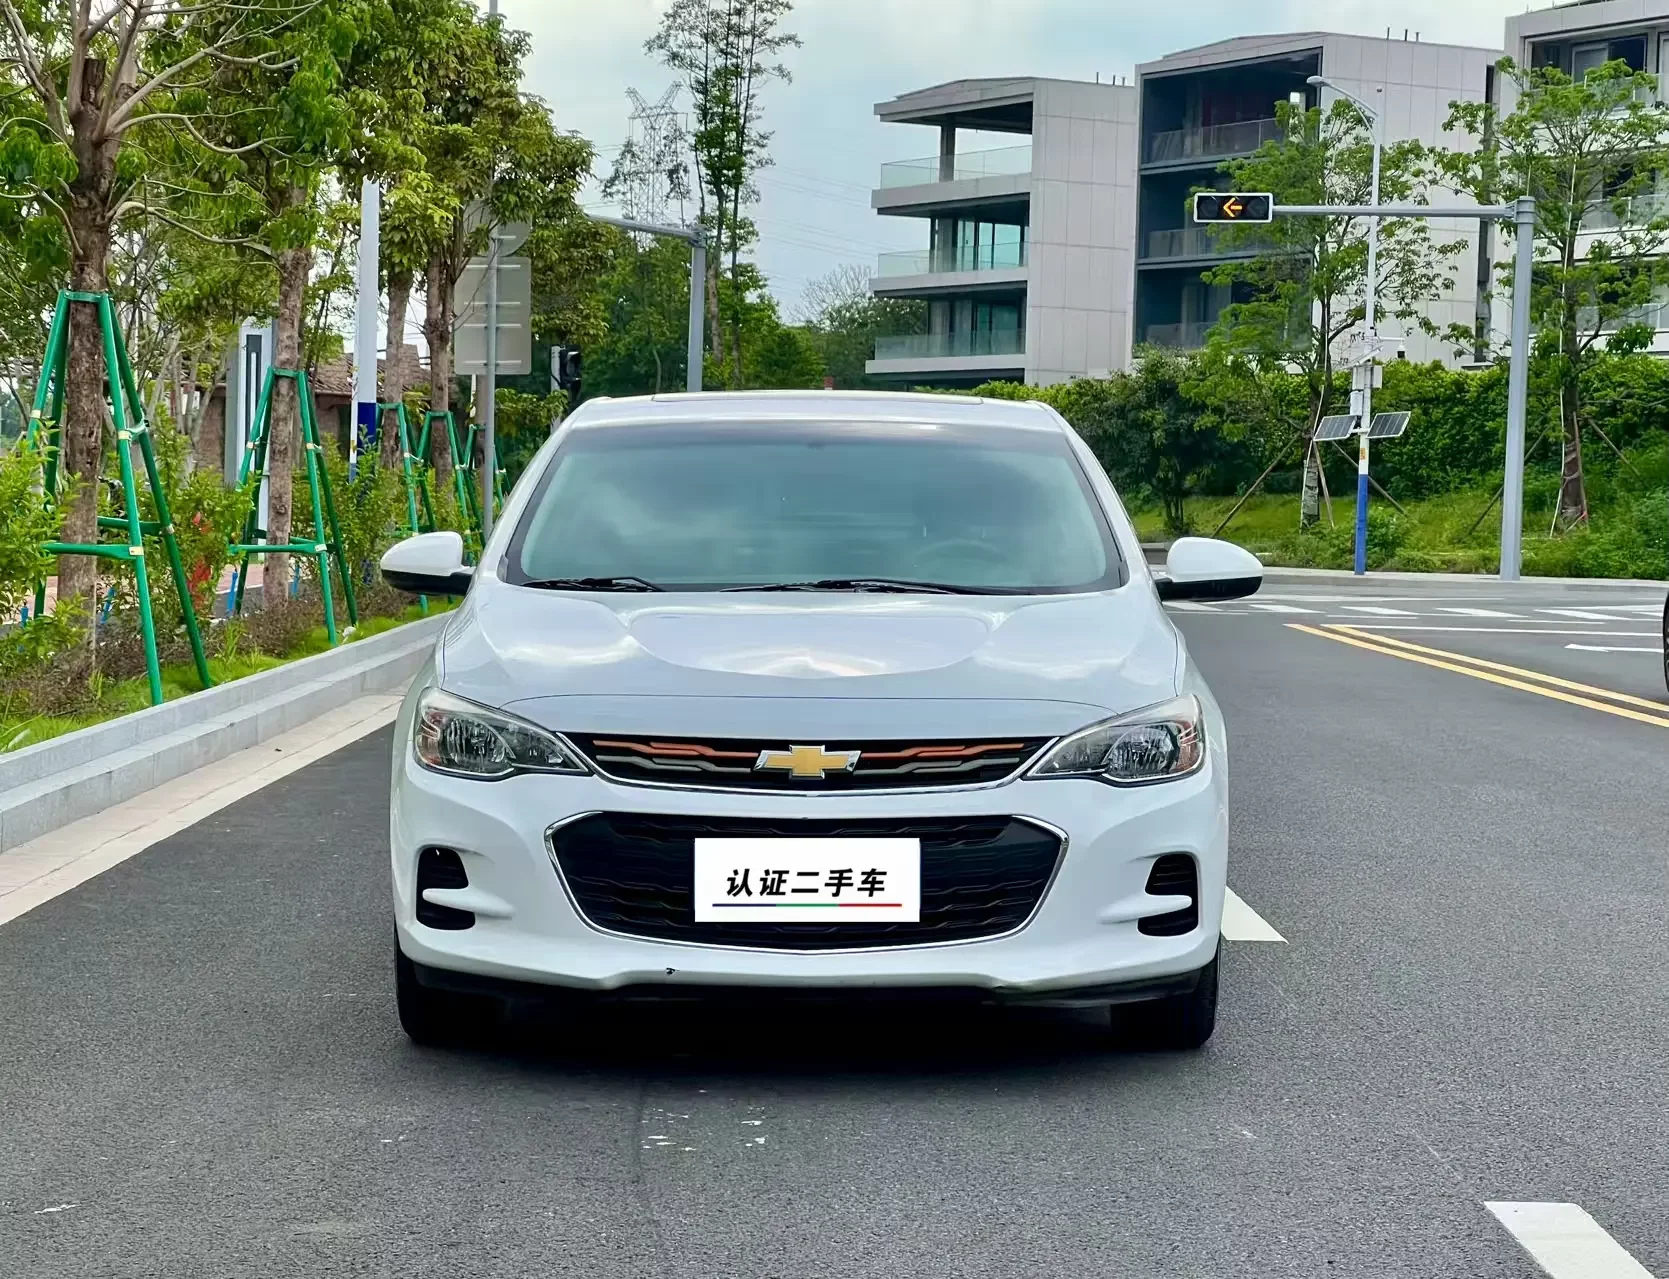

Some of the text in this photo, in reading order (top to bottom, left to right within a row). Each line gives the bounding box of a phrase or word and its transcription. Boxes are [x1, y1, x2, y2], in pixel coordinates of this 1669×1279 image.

[726, 868, 888, 898] 认证二手车
